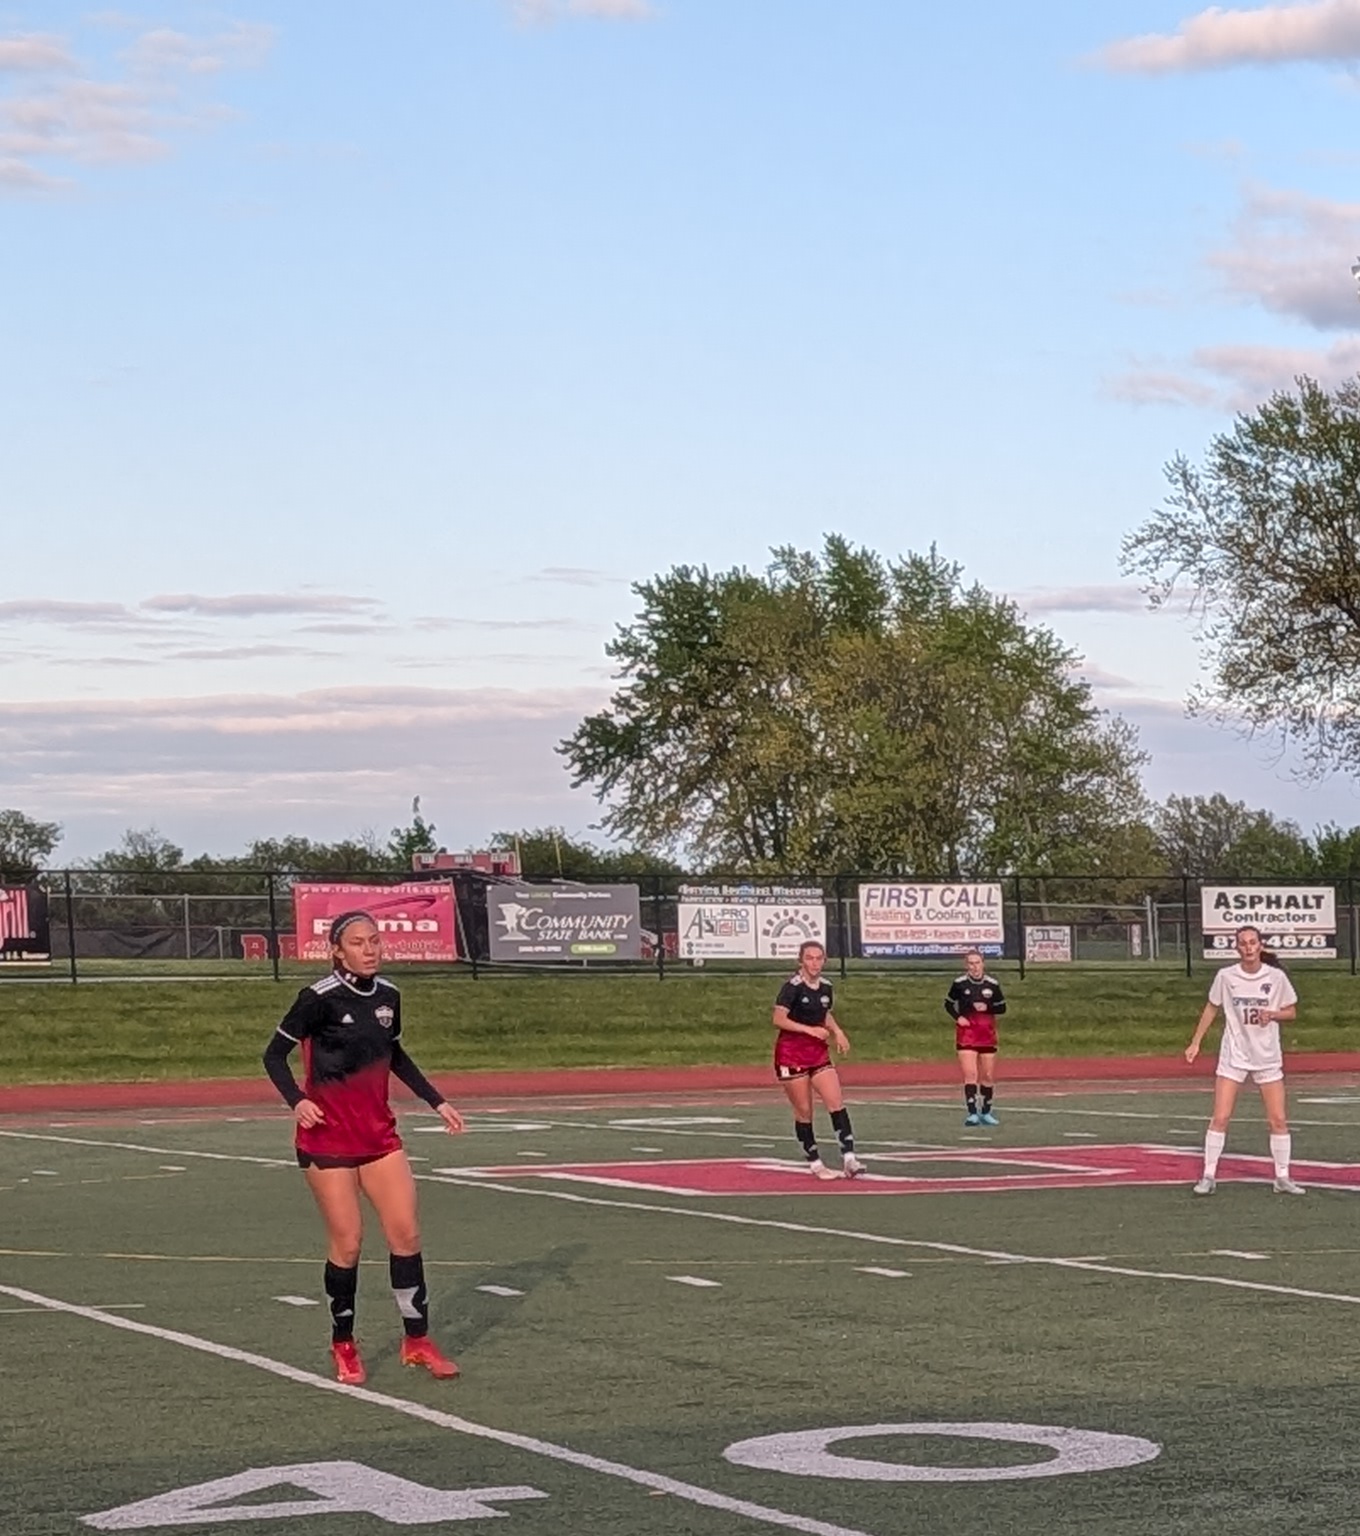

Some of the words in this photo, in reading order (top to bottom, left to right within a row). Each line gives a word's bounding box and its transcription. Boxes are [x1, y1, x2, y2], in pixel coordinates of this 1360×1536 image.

[865, 887, 933, 907] FIRST
[940, 887, 998, 907] CALL
[1214, 892, 1325, 909] ASPHALT
[520, 907, 633, 930] COMMUNITY
[864, 909, 911, 923] Heating
[914, 909, 923, 921] &
[978, 909, 998, 921] Inc.
[1222, 911, 1317, 923] Contractors
[538, 930, 573, 941] STATE
[578, 930, 613, 941] BANK
[1243, 1008, 1259, 1025] 12
